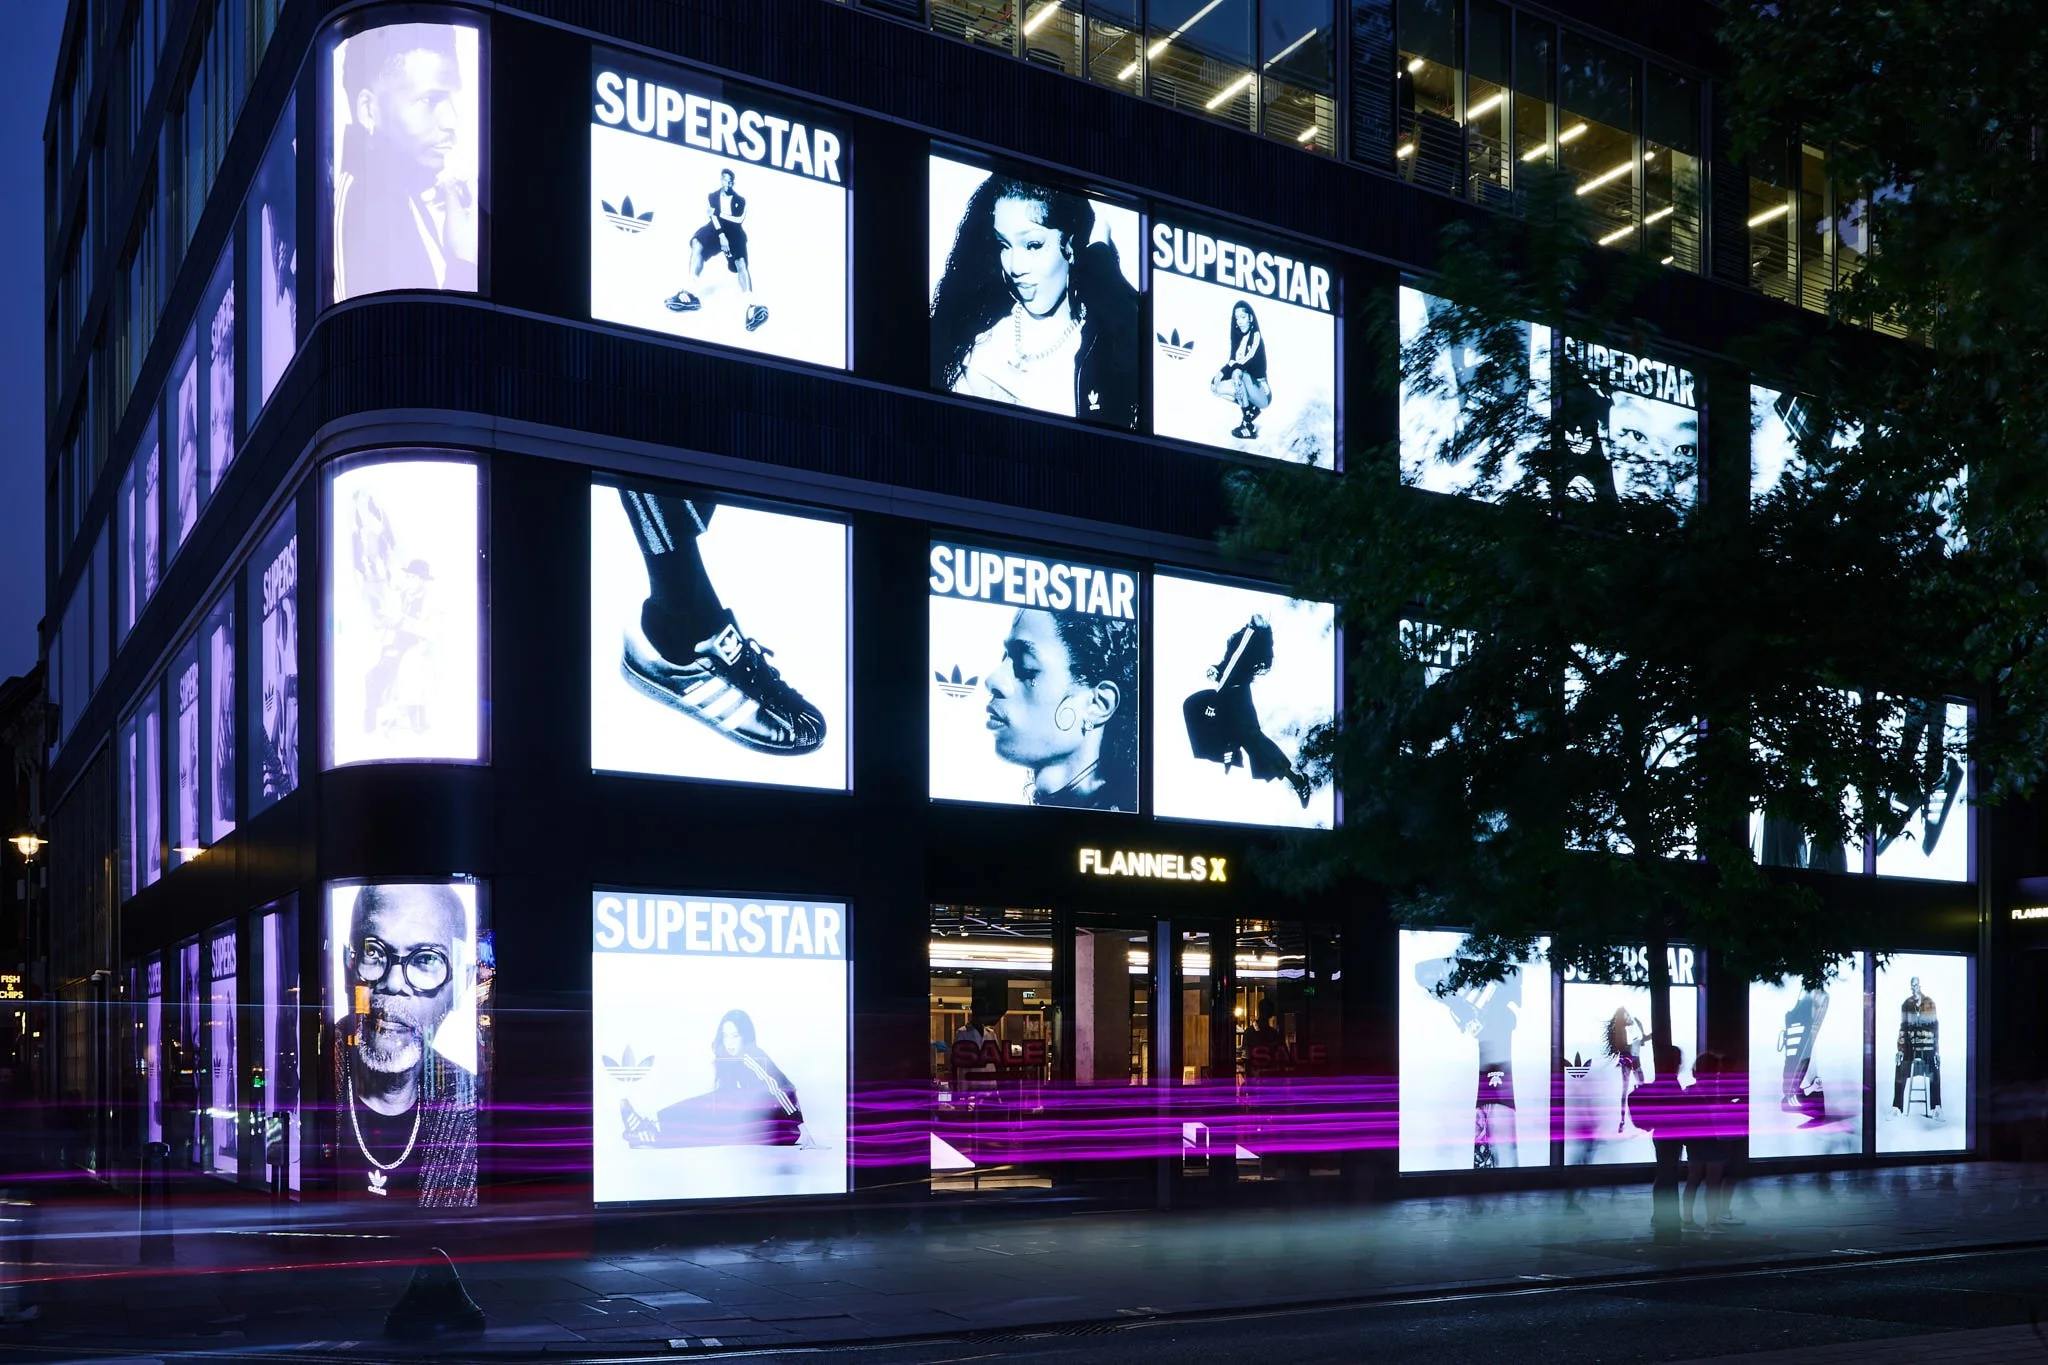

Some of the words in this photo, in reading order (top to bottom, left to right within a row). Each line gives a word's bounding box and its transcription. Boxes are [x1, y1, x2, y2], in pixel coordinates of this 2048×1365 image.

[594, 71, 841, 182] SUPERSTAR
[1153, 223, 1331, 311] SUPERSTAR
[929, 545, 1135, 620] SUPERSTAR
[1080, 848, 1207, 881] FLANNELS
[1209, 857, 1226, 882] X
[595, 897, 841, 955] SUPERSTAR
[0, 991, 24, 999] CHIPS
[1, 975, 21, 983] FISH
[7, 983, 14, 991] &
[951, 1039, 1046, 1070] SALE
